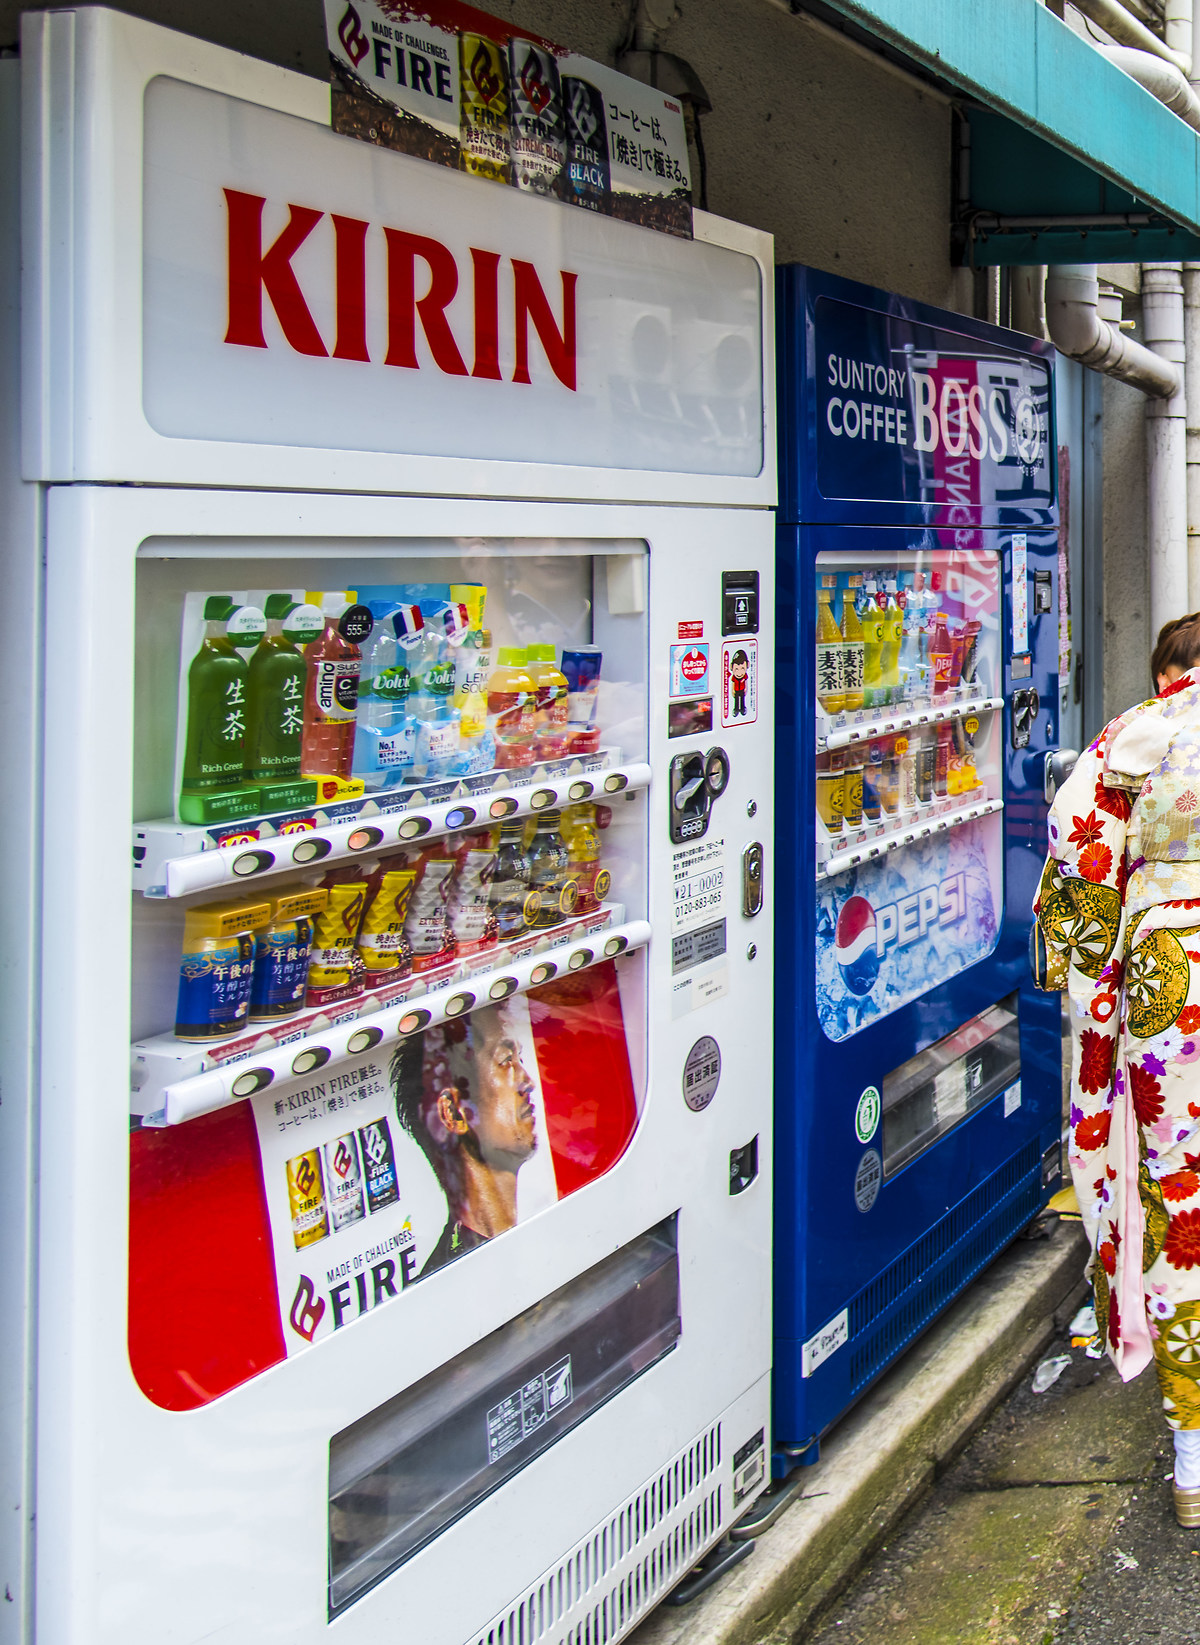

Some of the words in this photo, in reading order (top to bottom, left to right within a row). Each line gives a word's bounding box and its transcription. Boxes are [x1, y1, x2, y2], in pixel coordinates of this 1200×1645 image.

[371, 21, 393, 40] MADE
[395, 30, 404, 44] OF
[405, 34, 450, 61] CHALLENGES.
[372, 37, 453, 103] FIRE
[474, 107, 505, 130] FIRE
[609, 103, 667, 146] コーヒーは、
[574, 144, 600, 166] FIRE
[611, 131, 688, 187] 「焼き」で極まる。
[570, 163, 604, 190] BLACK
[226, 190, 577, 390] KIRIN
[828, 353, 906, 399] SUNTORY
[827, 397, 908, 446] COFFEE
[911, 371, 1008, 463] BOSS
[319, 662, 335, 709] amino
[340, 679, 351, 690] C
[818, 650, 837, 691] 麦茶
[836, 650, 844, 689] やさしい
[843, 649, 857, 688] 麦茶
[857, 648, 865, 688] やさしい
[221, 678, 246, 741] 生茶
[280, 674, 304, 735] 生茶
[201, 764, 223, 773] Rich
[261, 757, 282, 765] Rich
[675, 892, 722, 917] 0120-883-065
[874, 870, 967, 959] PEPSI
[337, 1178, 355, 1194] FIRE
[369, 1172, 394, 1190] BLACK
[371, 1162, 390, 1178] FIRE
[299, 1197, 318, 1212] FIRE
[326, 1260, 351, 1284] MADE
[353, 1254, 364, 1269] OF
[366, 1230, 416, 1266] CHALLENGES.
[328, 1244, 418, 1332] FIRE
